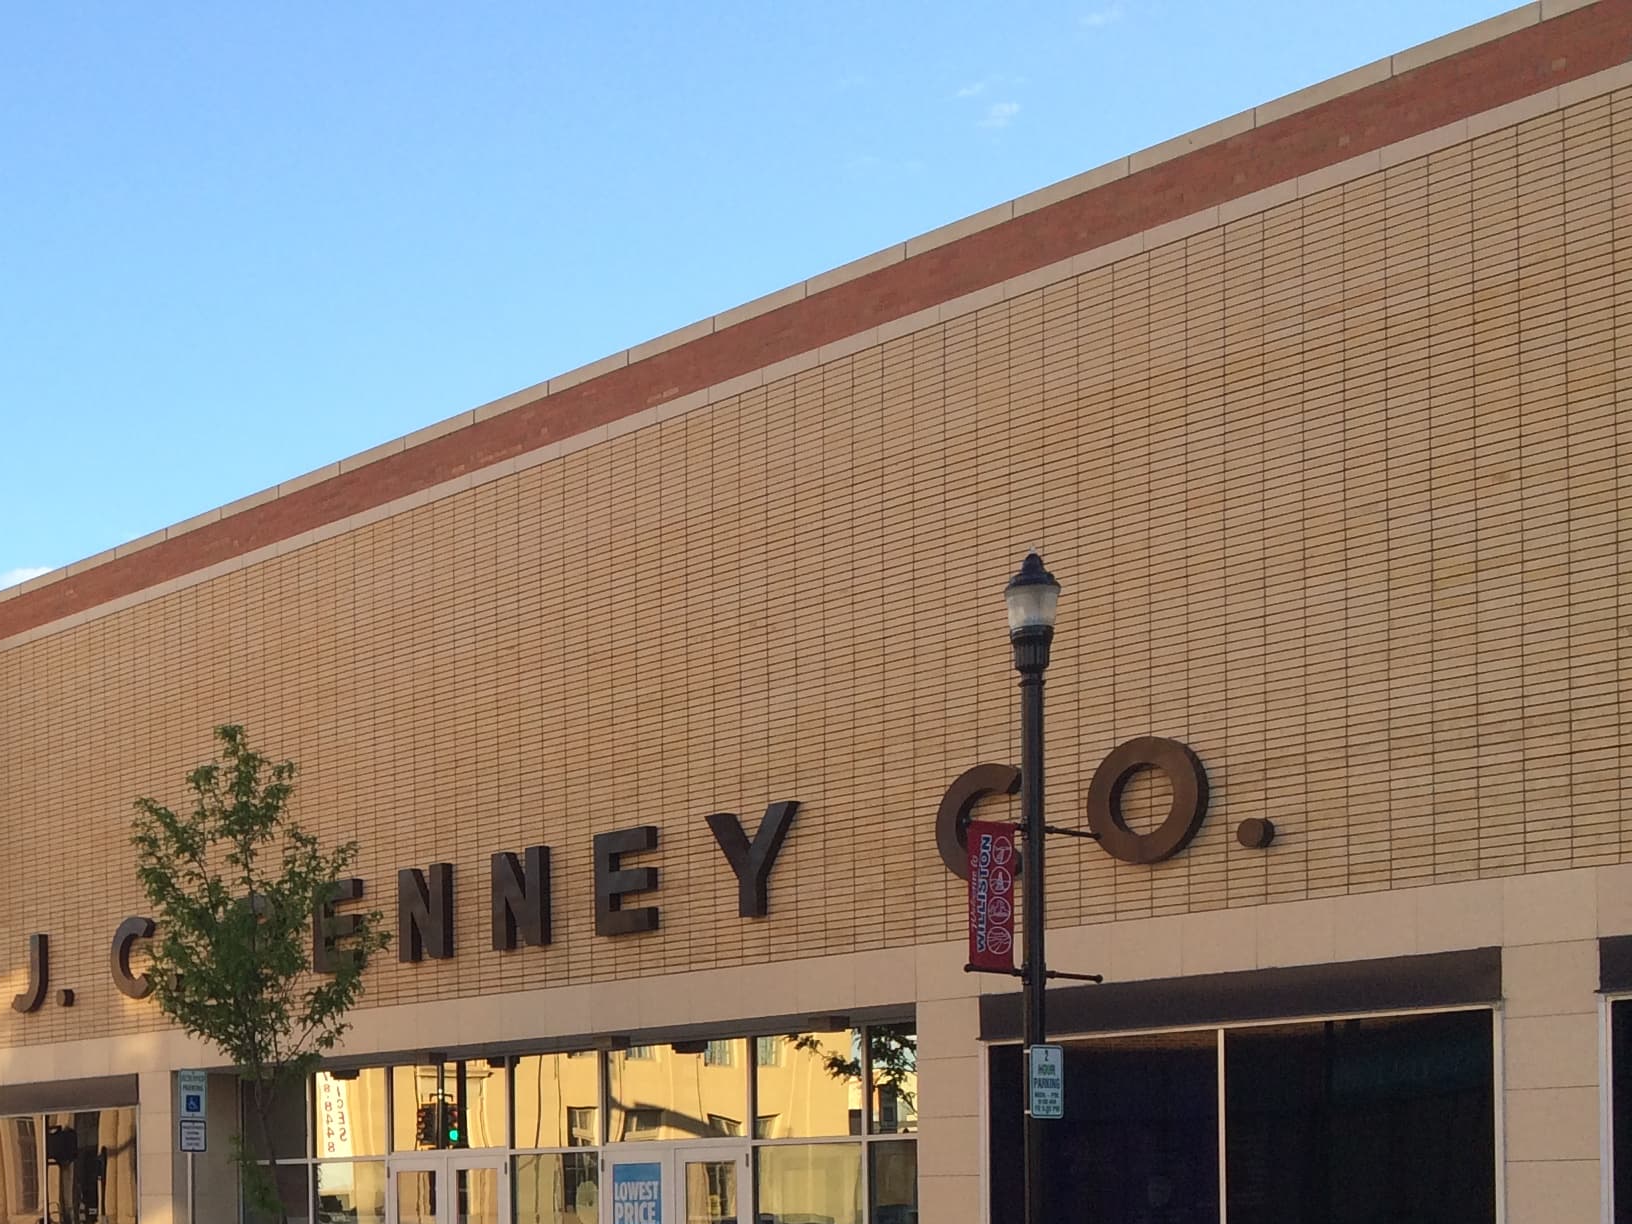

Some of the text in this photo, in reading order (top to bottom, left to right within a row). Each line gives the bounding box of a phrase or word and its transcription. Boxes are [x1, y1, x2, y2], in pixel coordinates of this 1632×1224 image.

[223, 801, 801, 988] ENNEY
[935, 735, 1275, 884] CO.
[976, 834, 993, 953] WILLISTON
[1044, 1049, 1049, 1062] 2
[1037, 1063, 1056, 1076] HOUR
[1033, 1077, 1061, 1089] PARKING
[614, 1181, 659, 1201] LOWEST
